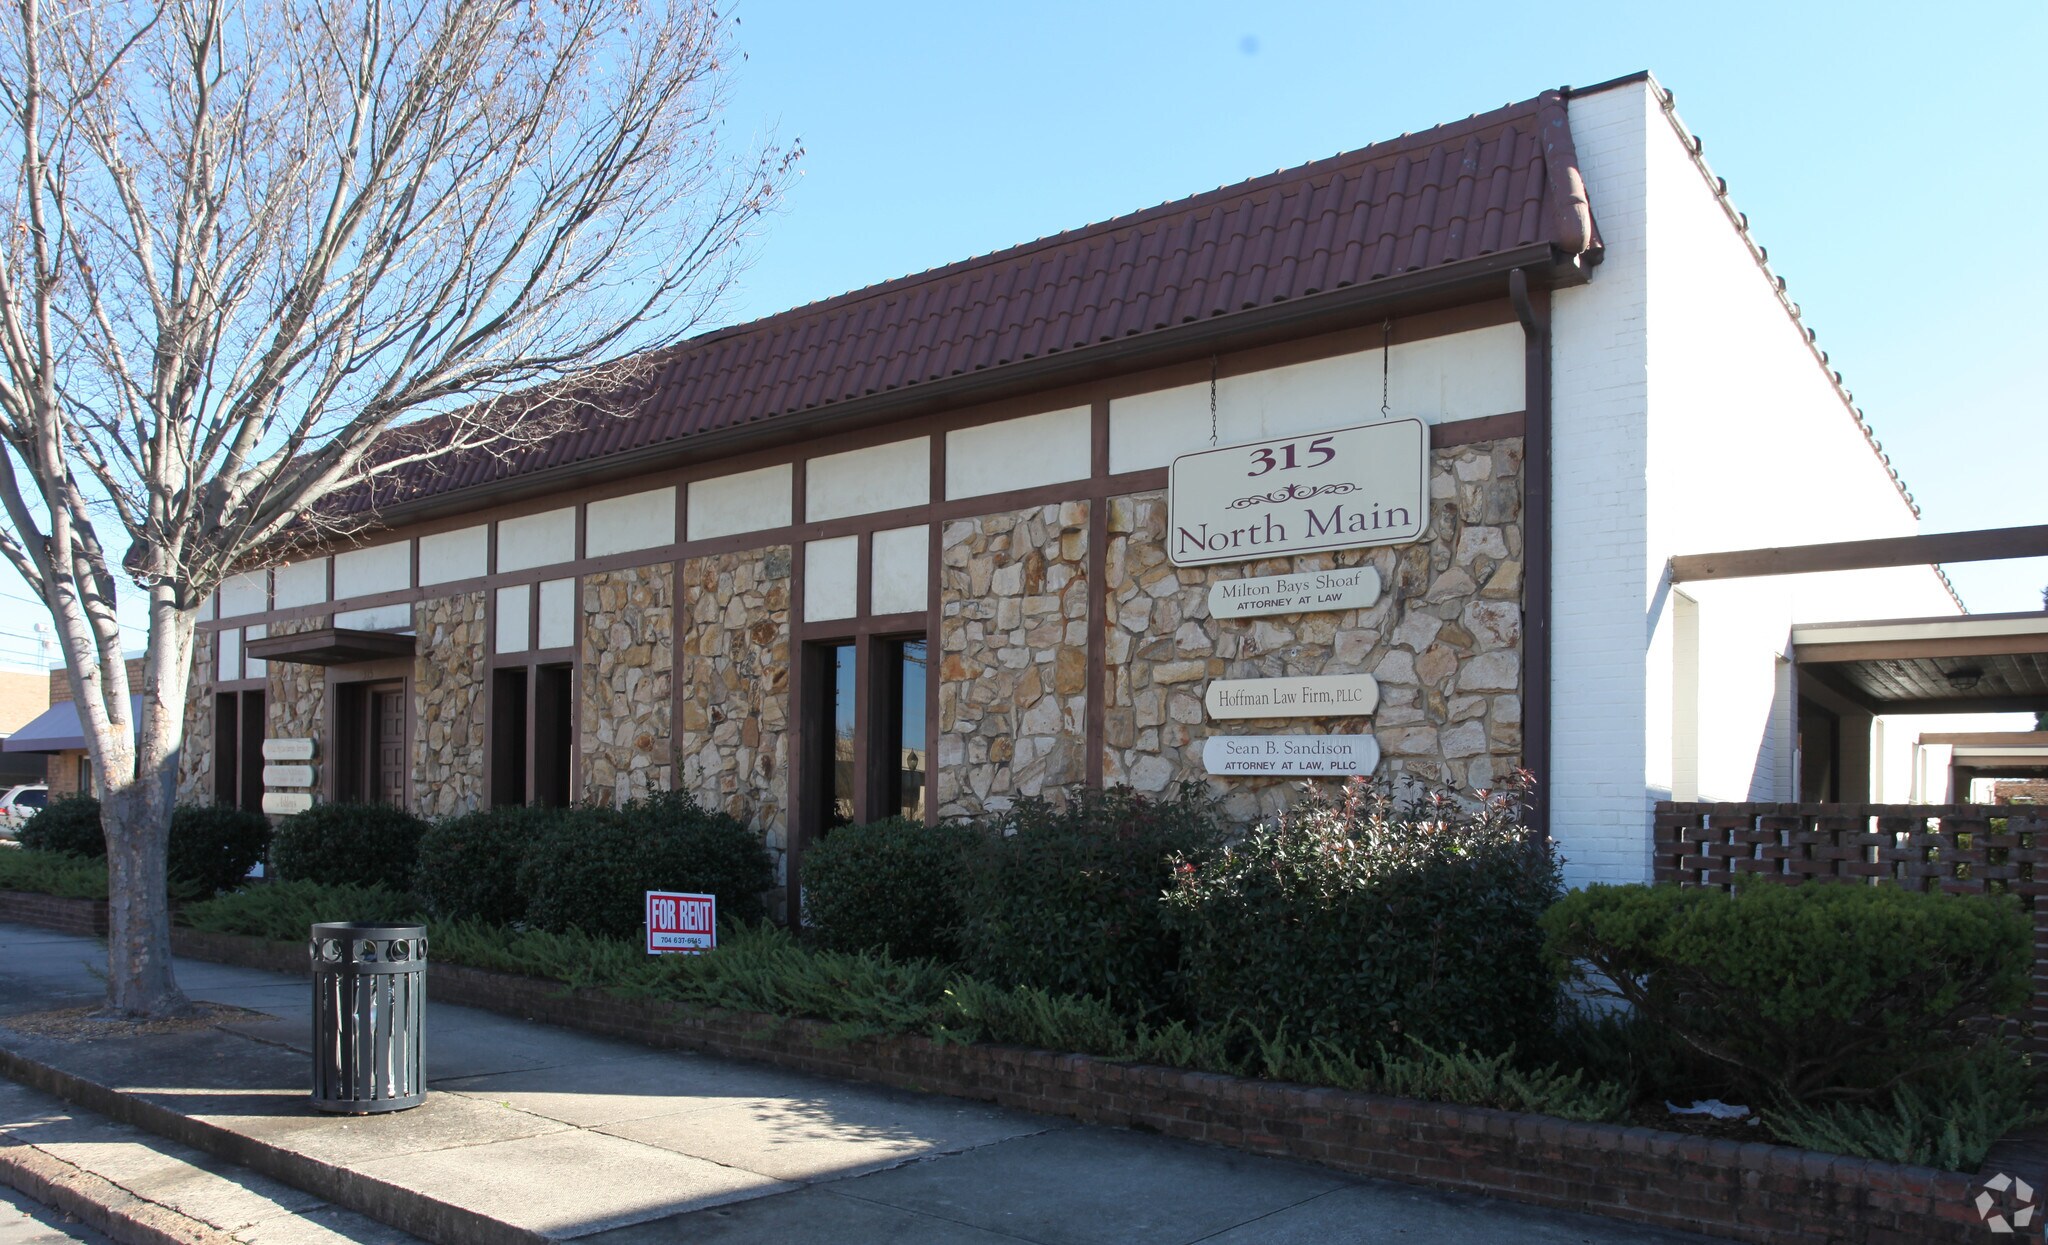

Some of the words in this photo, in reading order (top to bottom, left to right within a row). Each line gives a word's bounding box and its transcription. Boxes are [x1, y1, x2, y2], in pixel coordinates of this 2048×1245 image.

[1247, 436, 1336, 477] 315
[1177, 513, 1288, 554] North
[1304, 502, 1412, 538] Main
[1222, 583, 1270, 599] Milton
[1277, 579, 1310, 596] Bays
[1316, 571, 1362, 589] Shoaf
[1237, 598, 1292, 610] ATTORNEY
[1298, 596, 1311, 604] AT
[1318, 593, 1343, 603] LAW
[1219, 689, 1269, 707] Hoffman
[1273, 688, 1297, 704] Law
[1302, 686, 1335, 705] Firm,
[1336, 688, 1362, 702] PLLC
[1226, 740, 1260, 755] Sean
[1266, 741, 1279, 755] B.
[1284, 740, 1352, 755] Sandison
[1225, 761, 1275, 770] ATTORNEY
[1281, 761, 1293, 770] AT
[1299, 761, 1324, 771] LAW,
[1330, 761, 1357, 770] PLLC
[652, 899, 676, 930] FOR
[680, 901, 710, 931] RENT
